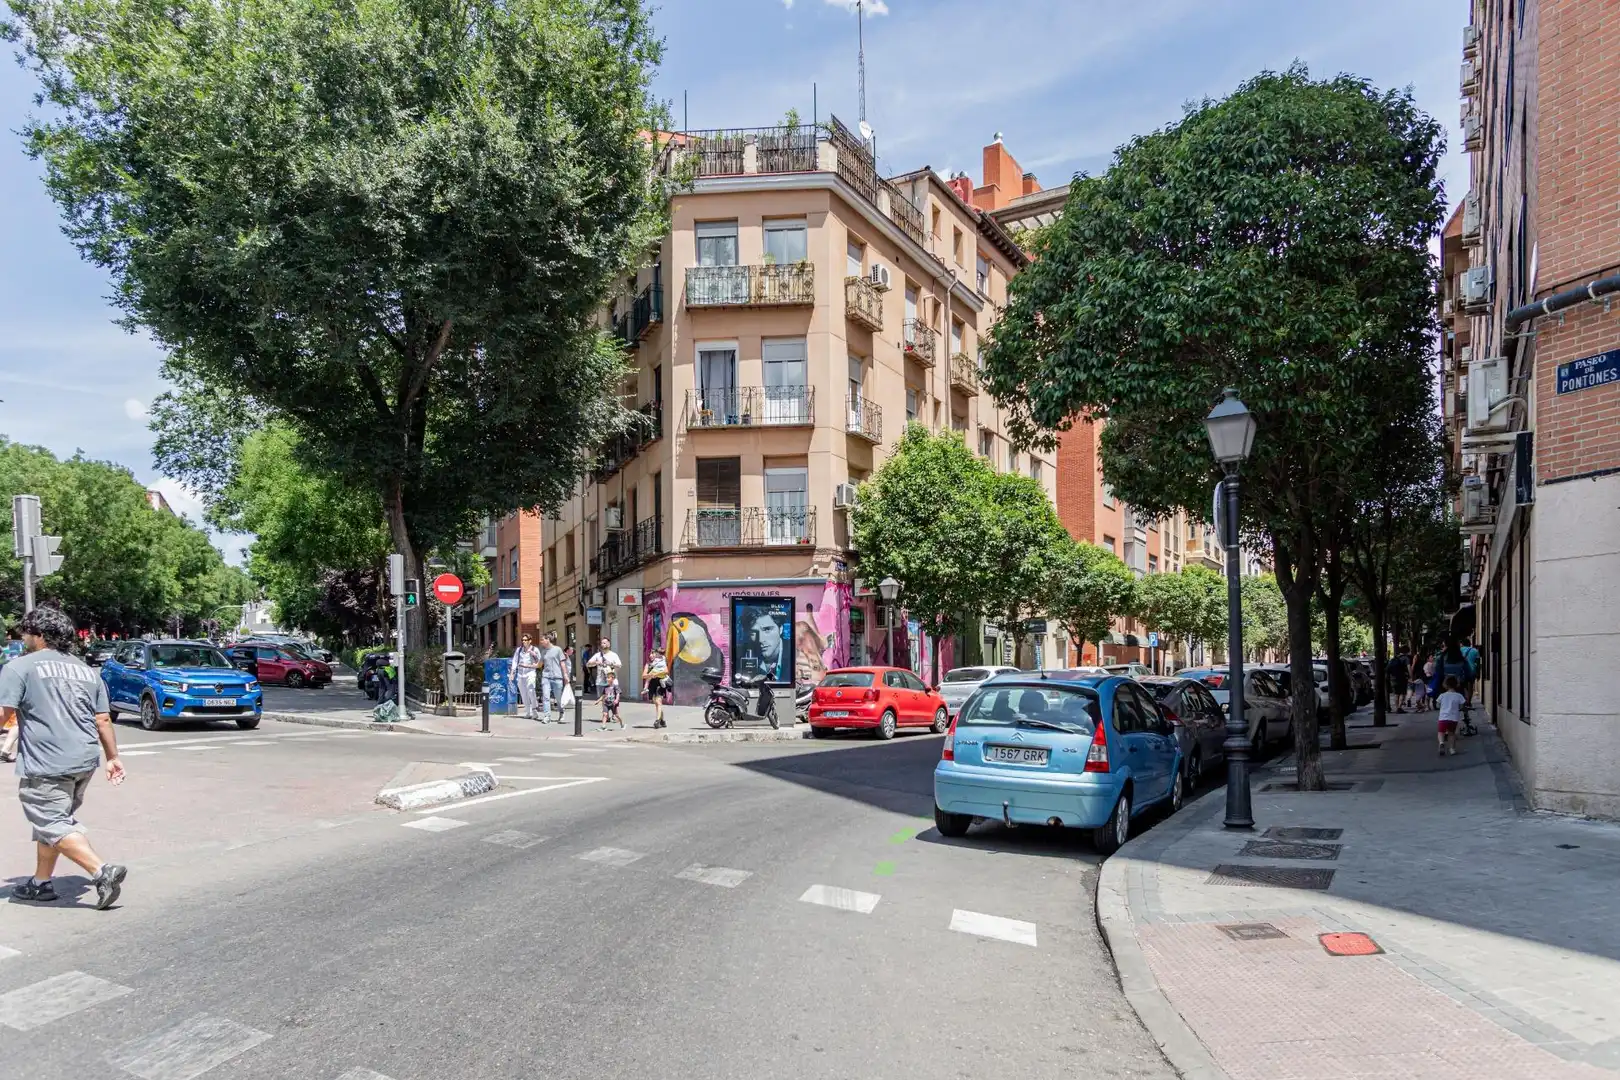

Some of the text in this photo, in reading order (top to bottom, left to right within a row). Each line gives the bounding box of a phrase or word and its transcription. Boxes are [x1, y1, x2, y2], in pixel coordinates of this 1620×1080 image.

[1575, 355, 1606, 370] PASEO
[1562, 368, 1617, 392] PONTONES
[994, 748, 1044, 762] 1567 GRK
